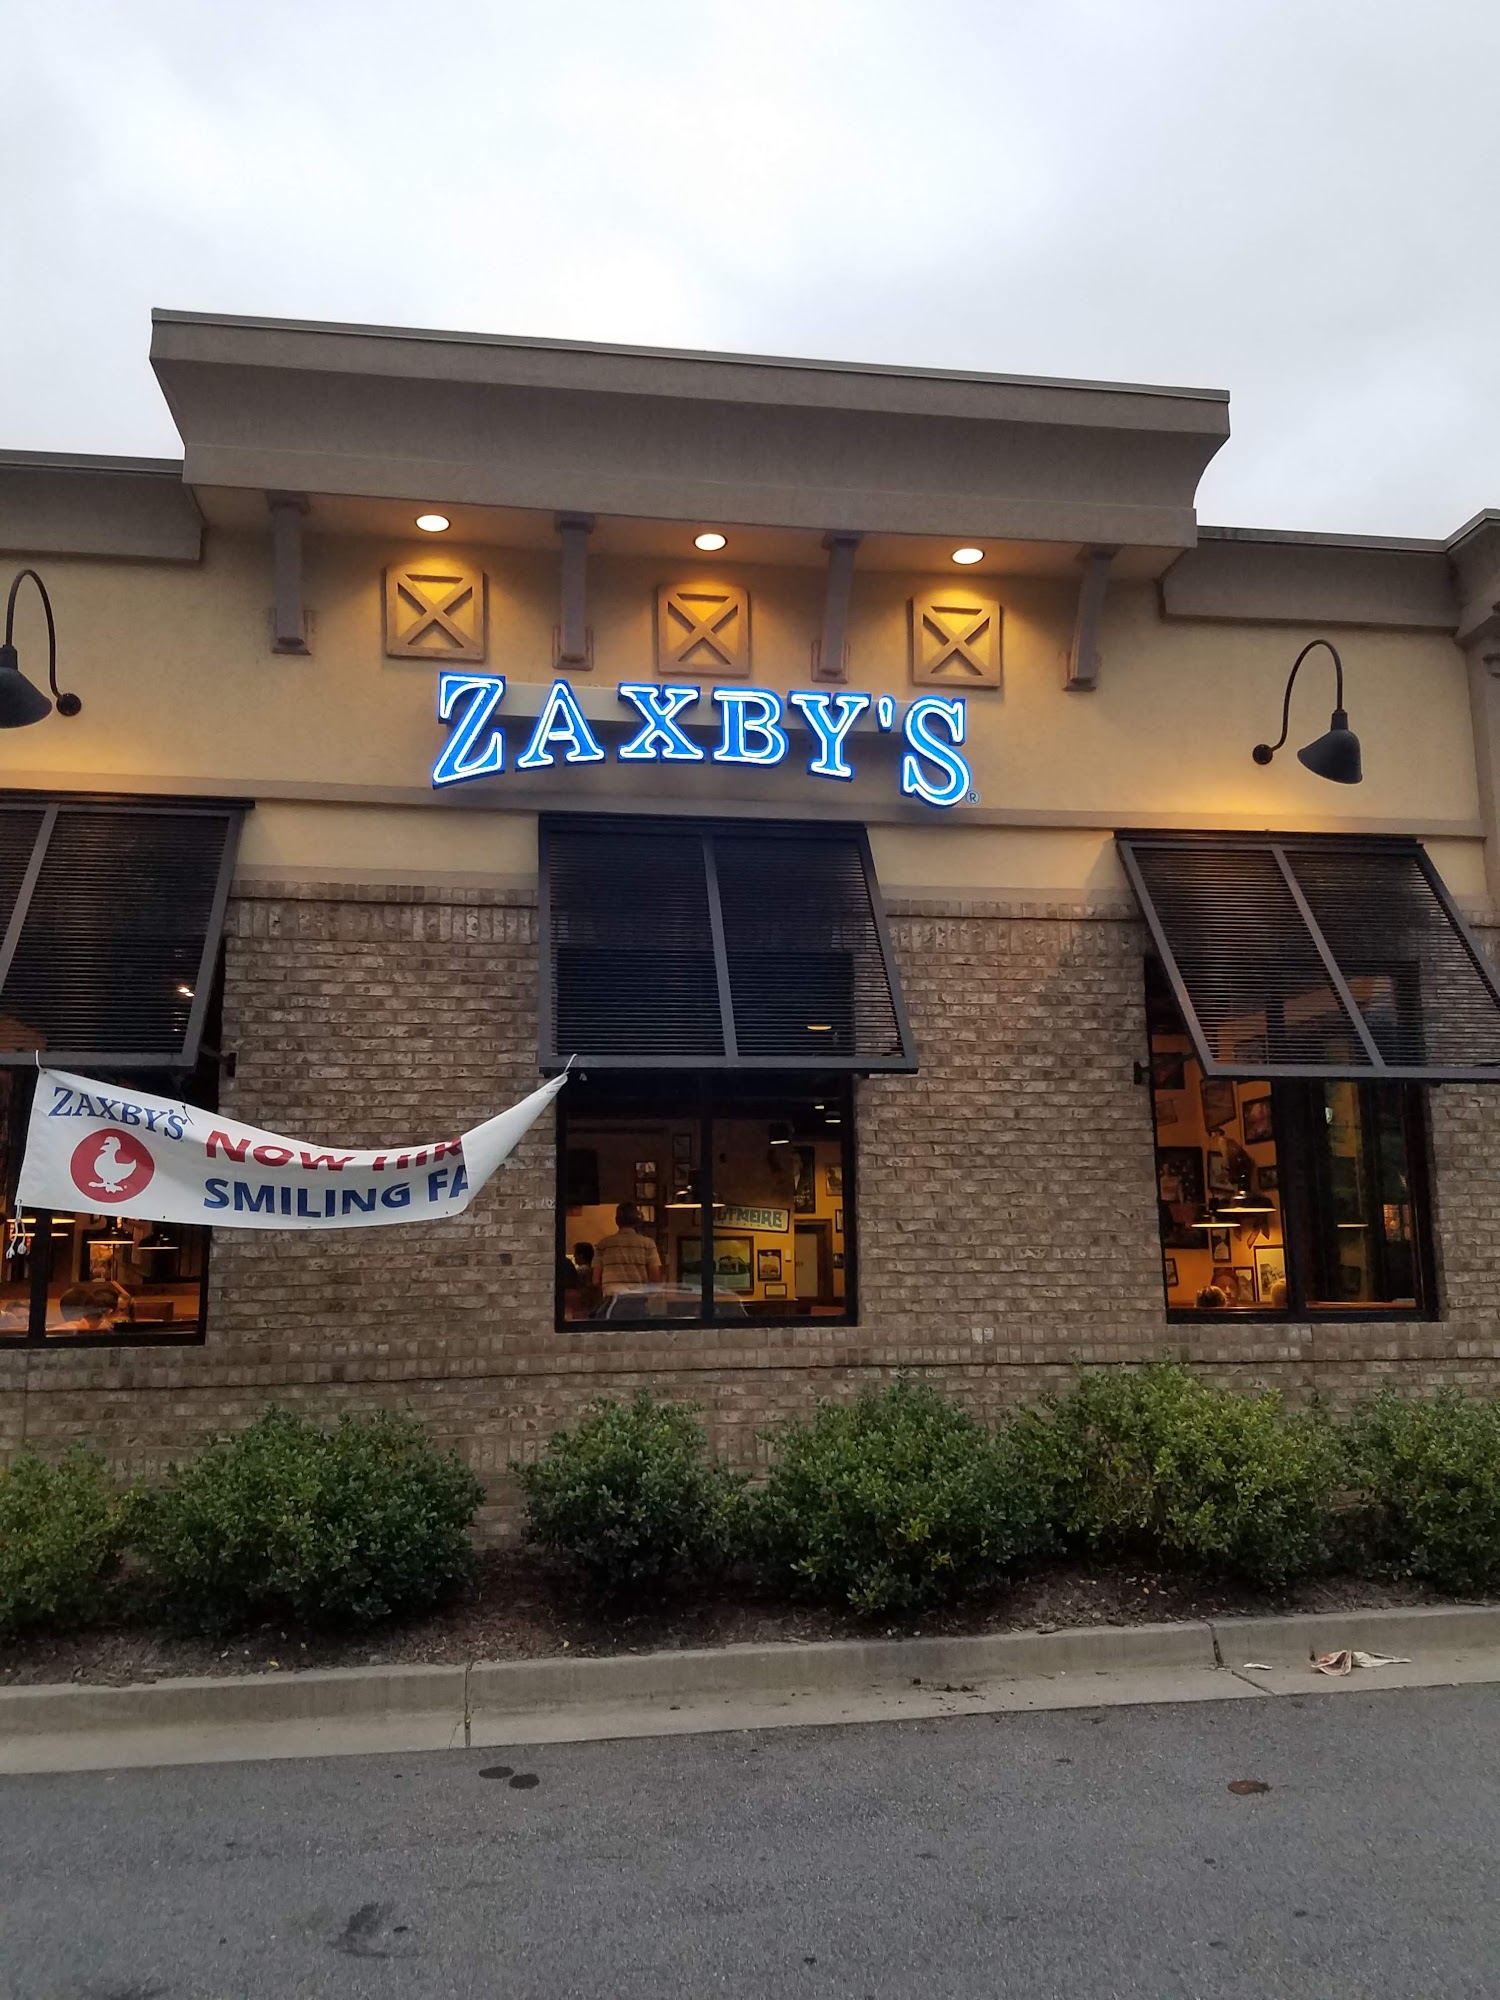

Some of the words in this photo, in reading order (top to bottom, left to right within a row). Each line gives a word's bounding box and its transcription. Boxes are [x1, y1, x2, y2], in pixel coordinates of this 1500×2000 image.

[433, 672, 970, 809] ZAXBY'S
[49, 1086, 187, 1141] ZAXBY'S
[206, 1130, 356, 1171] NOW
[204, 1178, 411, 1218] SMILING
